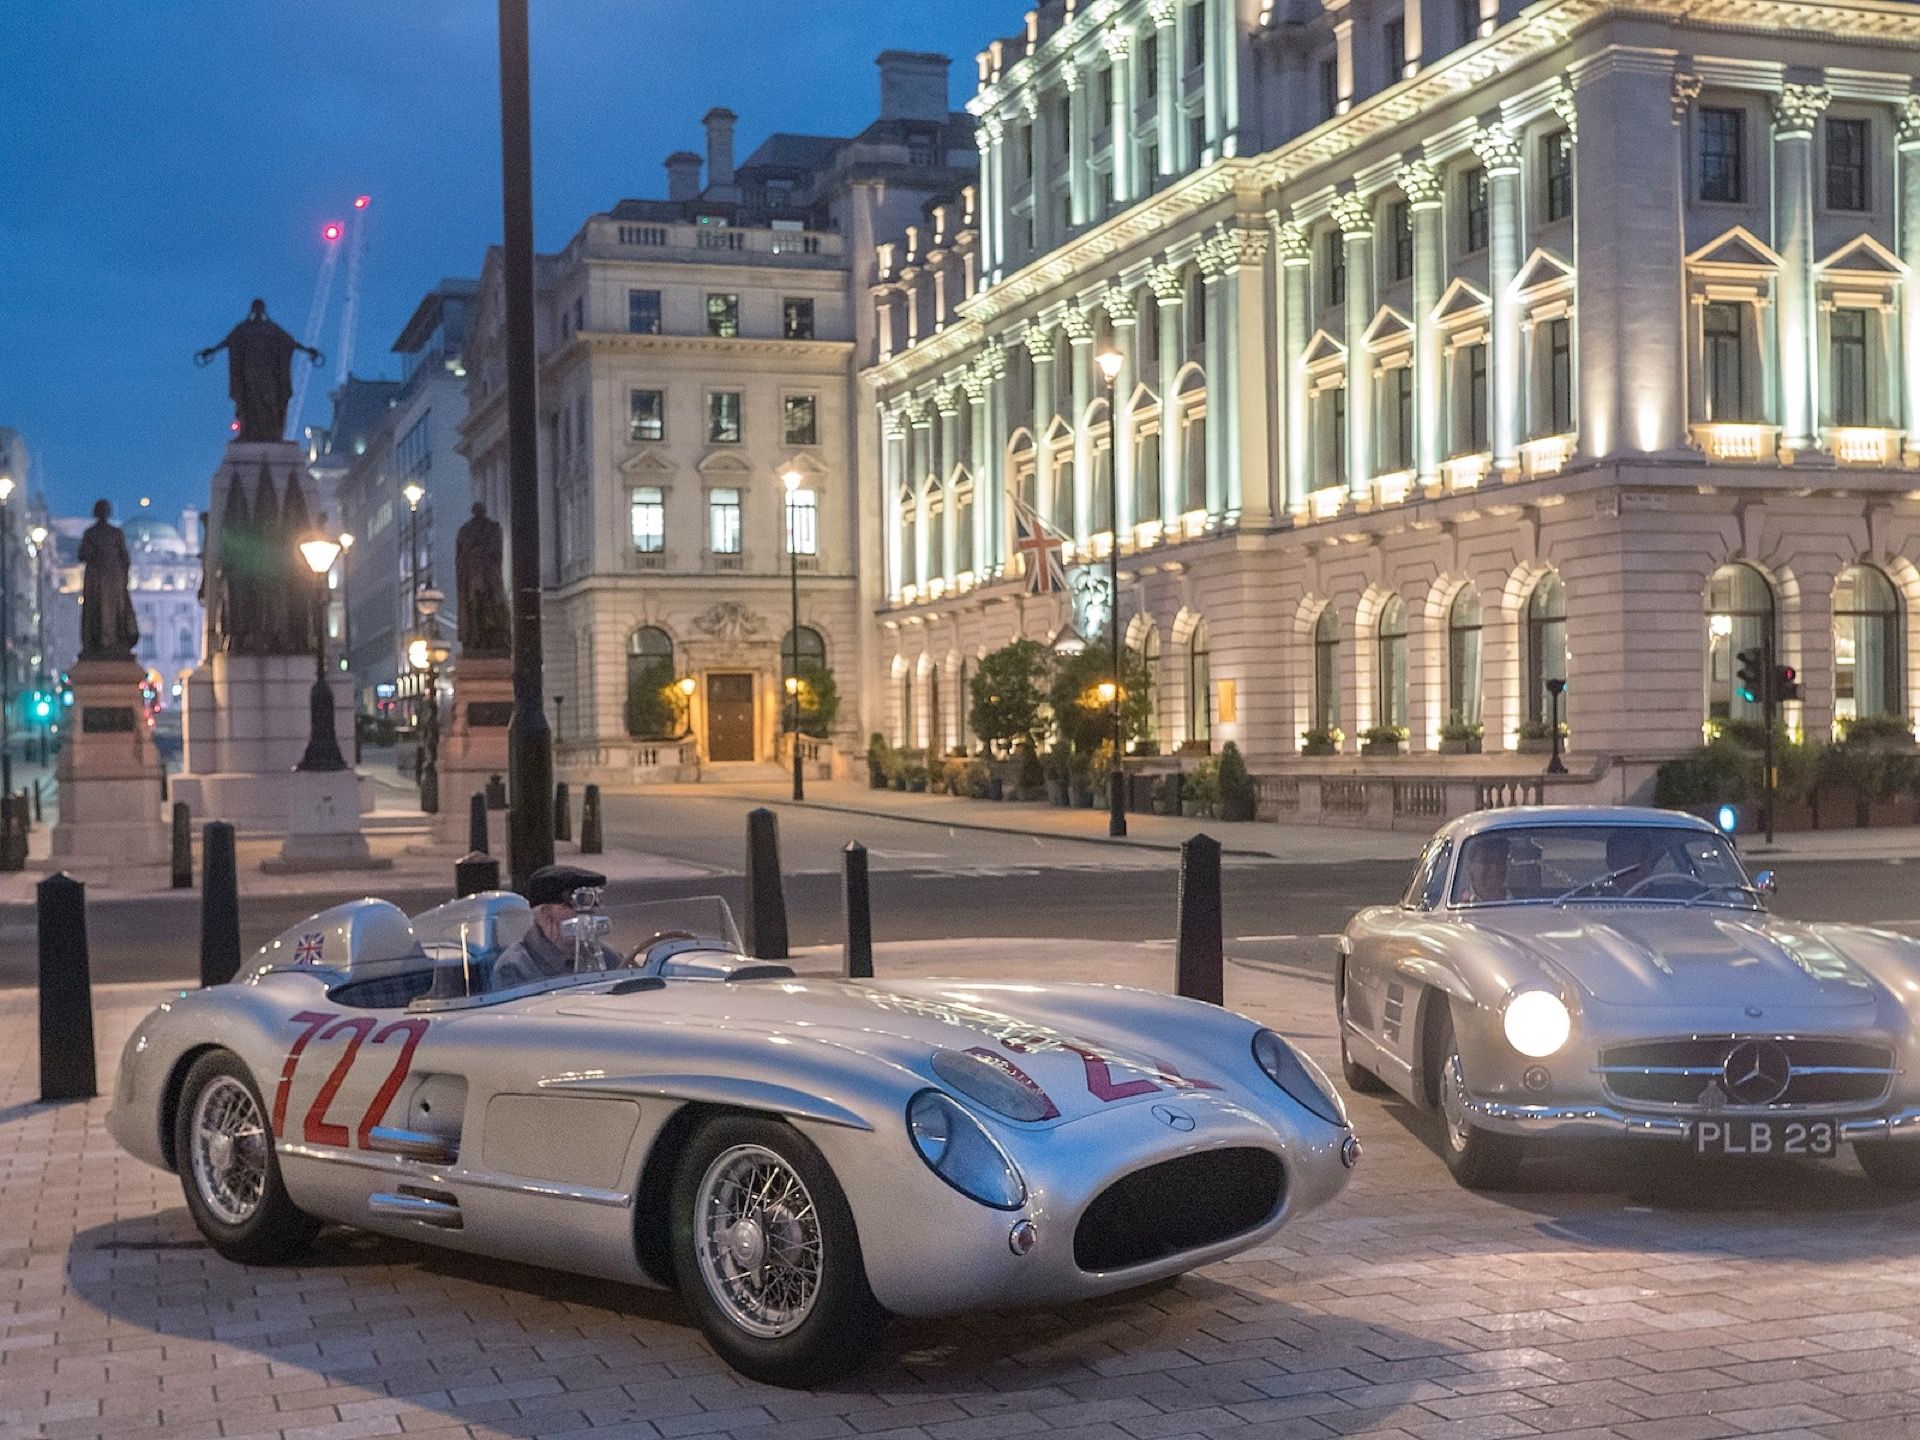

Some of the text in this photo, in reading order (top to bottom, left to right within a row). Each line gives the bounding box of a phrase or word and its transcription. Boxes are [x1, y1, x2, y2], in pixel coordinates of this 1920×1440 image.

[272, 1010, 431, 1150] 722
[1698, 1121, 1832, 1153] PLB 23
